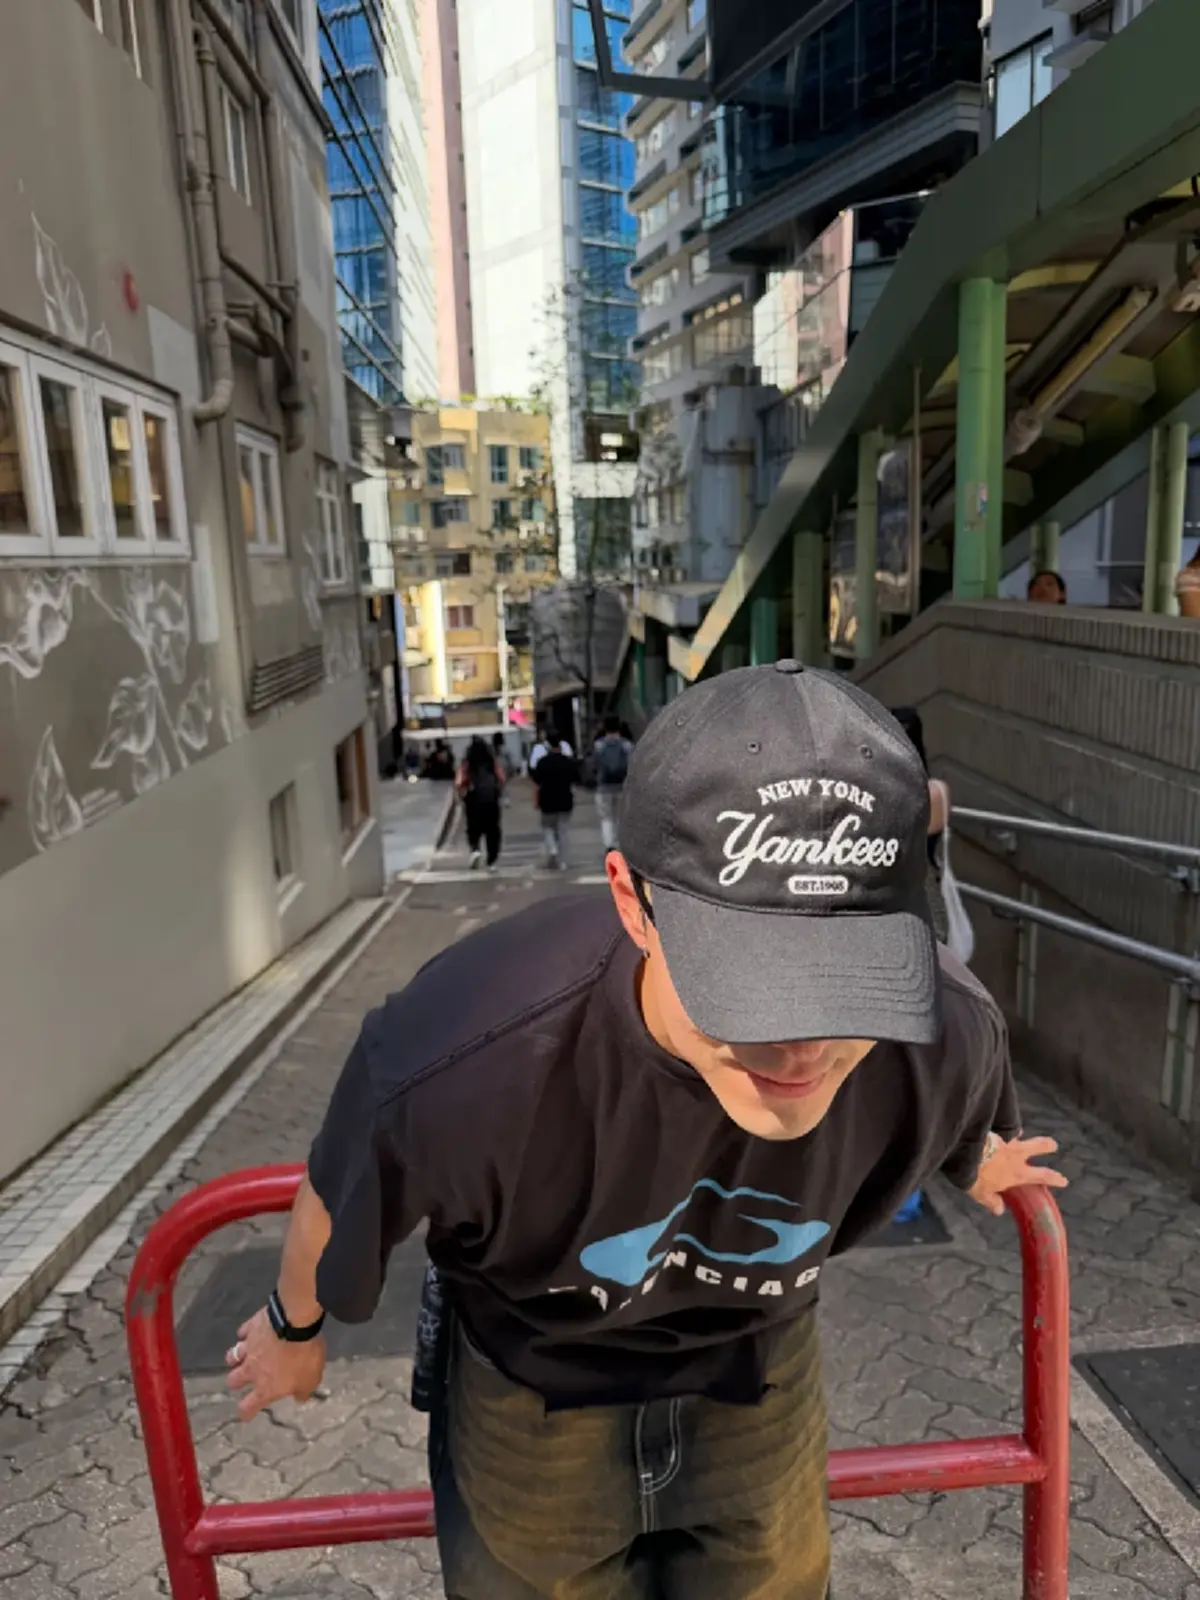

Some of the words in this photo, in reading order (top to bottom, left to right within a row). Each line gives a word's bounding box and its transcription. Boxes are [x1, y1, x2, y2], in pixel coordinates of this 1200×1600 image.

[757, 778, 813, 806] NEW
[817, 779, 876, 813] YORK
[716, 810, 899, 886] Yankees
